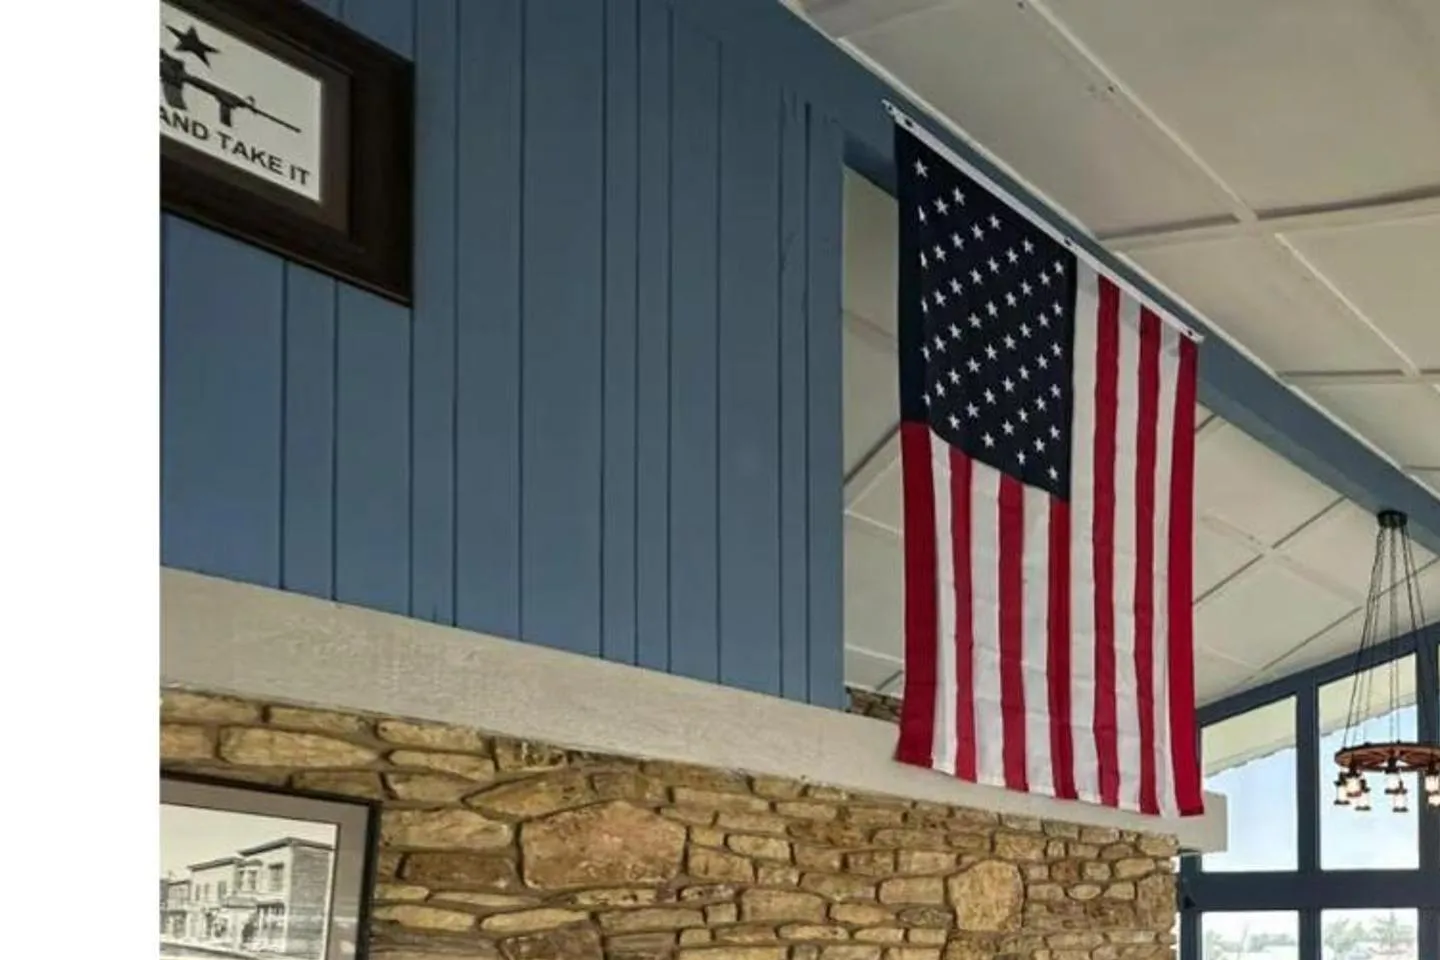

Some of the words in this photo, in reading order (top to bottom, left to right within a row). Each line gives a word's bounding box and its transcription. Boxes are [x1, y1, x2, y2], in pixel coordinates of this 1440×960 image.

[160, 105, 209, 140] AND
[217, 131, 283, 175] TAKE
[289, 165, 310, 185] IT
